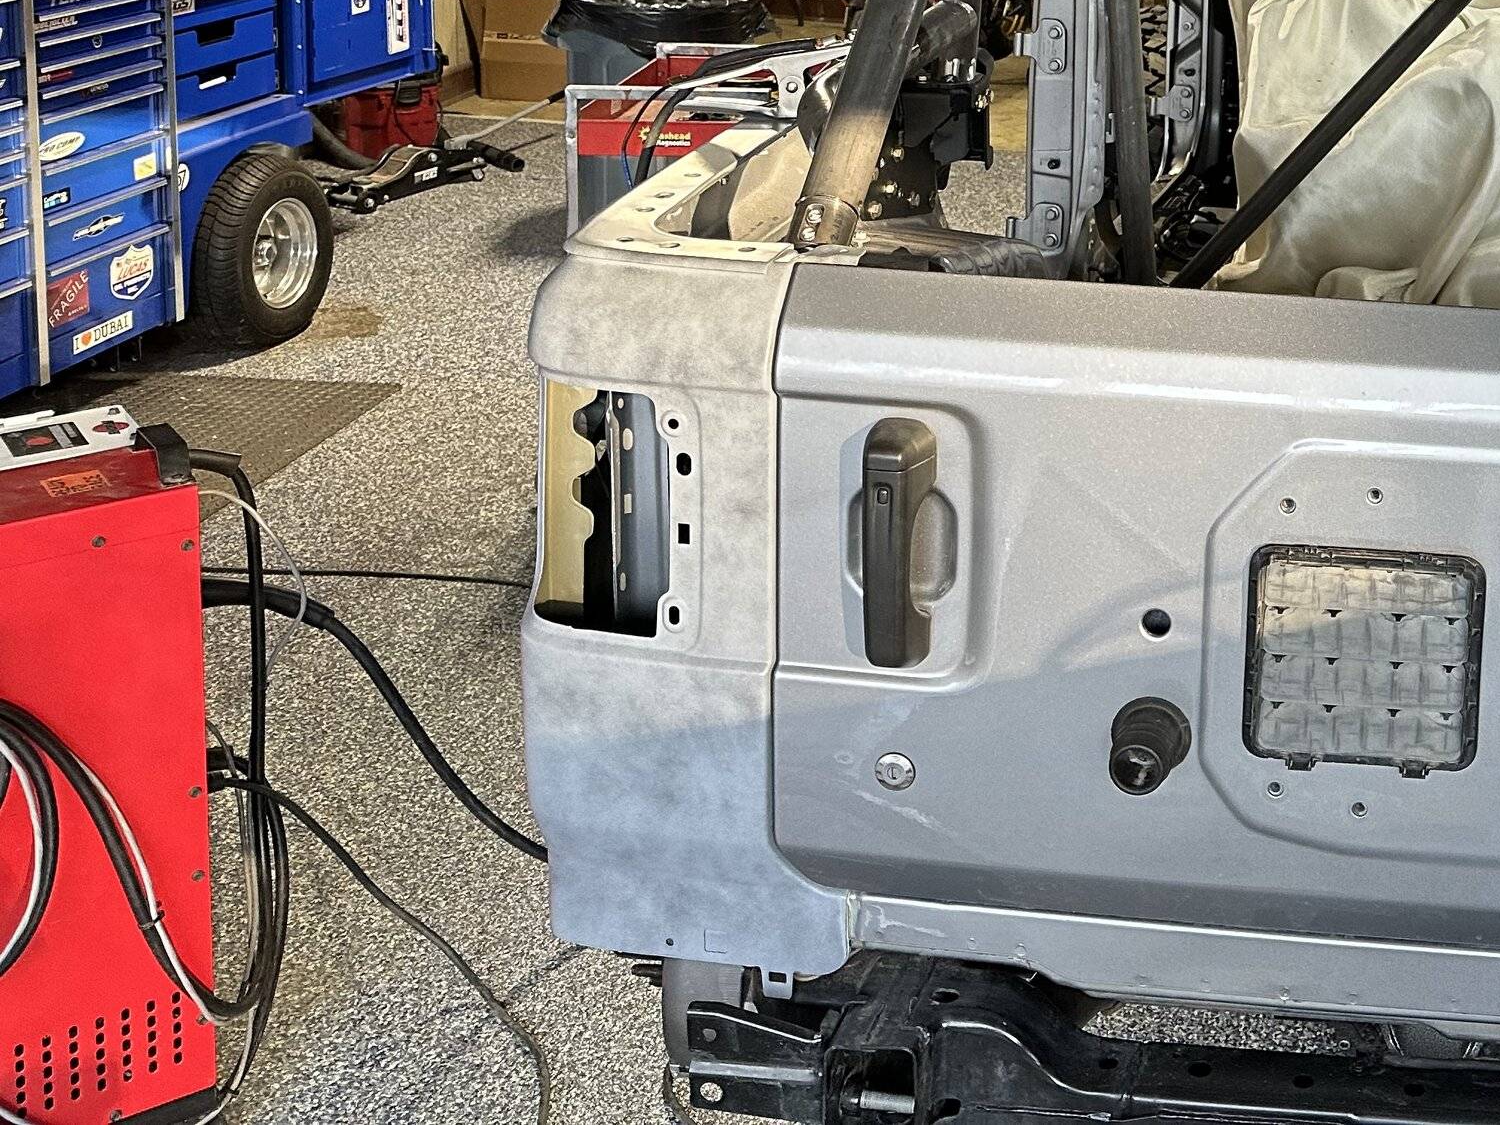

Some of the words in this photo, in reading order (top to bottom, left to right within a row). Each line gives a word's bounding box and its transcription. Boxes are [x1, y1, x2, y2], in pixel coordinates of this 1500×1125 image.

[118, 258, 150, 281] LUCAS
[48, 269, 89, 328] FRAGILE
[75, 337, 80, 351] I
[93, 315, 129, 342] DUBAI
